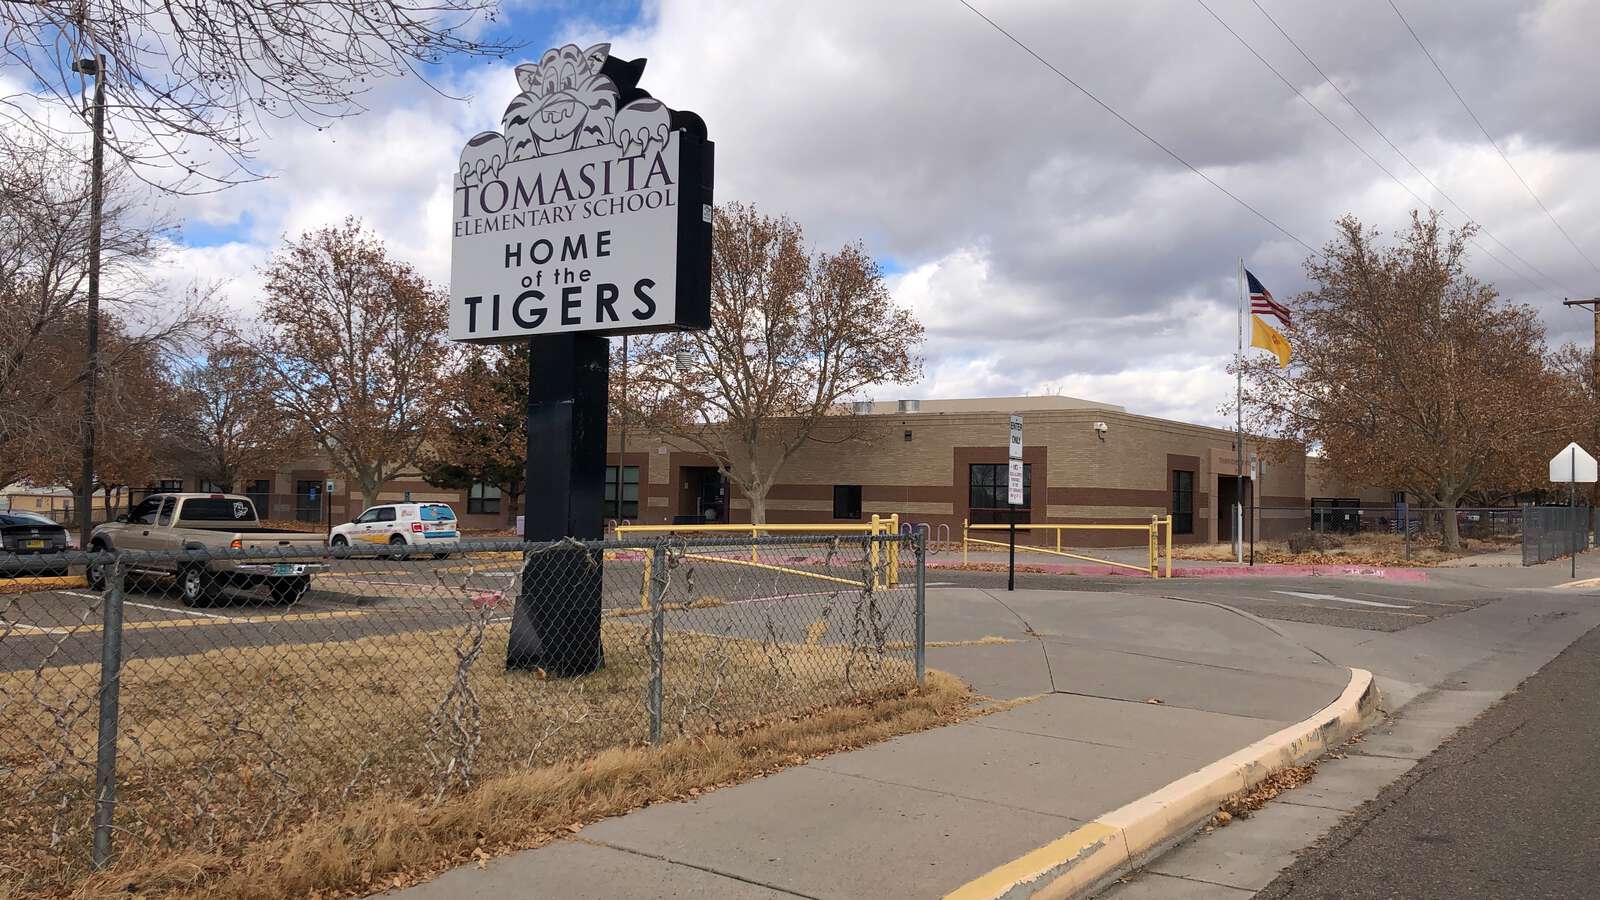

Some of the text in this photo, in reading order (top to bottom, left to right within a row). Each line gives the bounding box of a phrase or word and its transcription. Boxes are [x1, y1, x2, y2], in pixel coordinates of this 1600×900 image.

[456, 150, 675, 217] TOMASITA
[455, 204, 576, 238] ELEMENTARY
[582, 189, 675, 219] SCHOOL
[505, 230, 611, 268] HOME
[521, 267, 591, 288] of the
[464, 278, 657, 333] TIGERS
[1010, 422, 1022, 431] ENTER
[1012, 435, 1021, 445] ONLY
